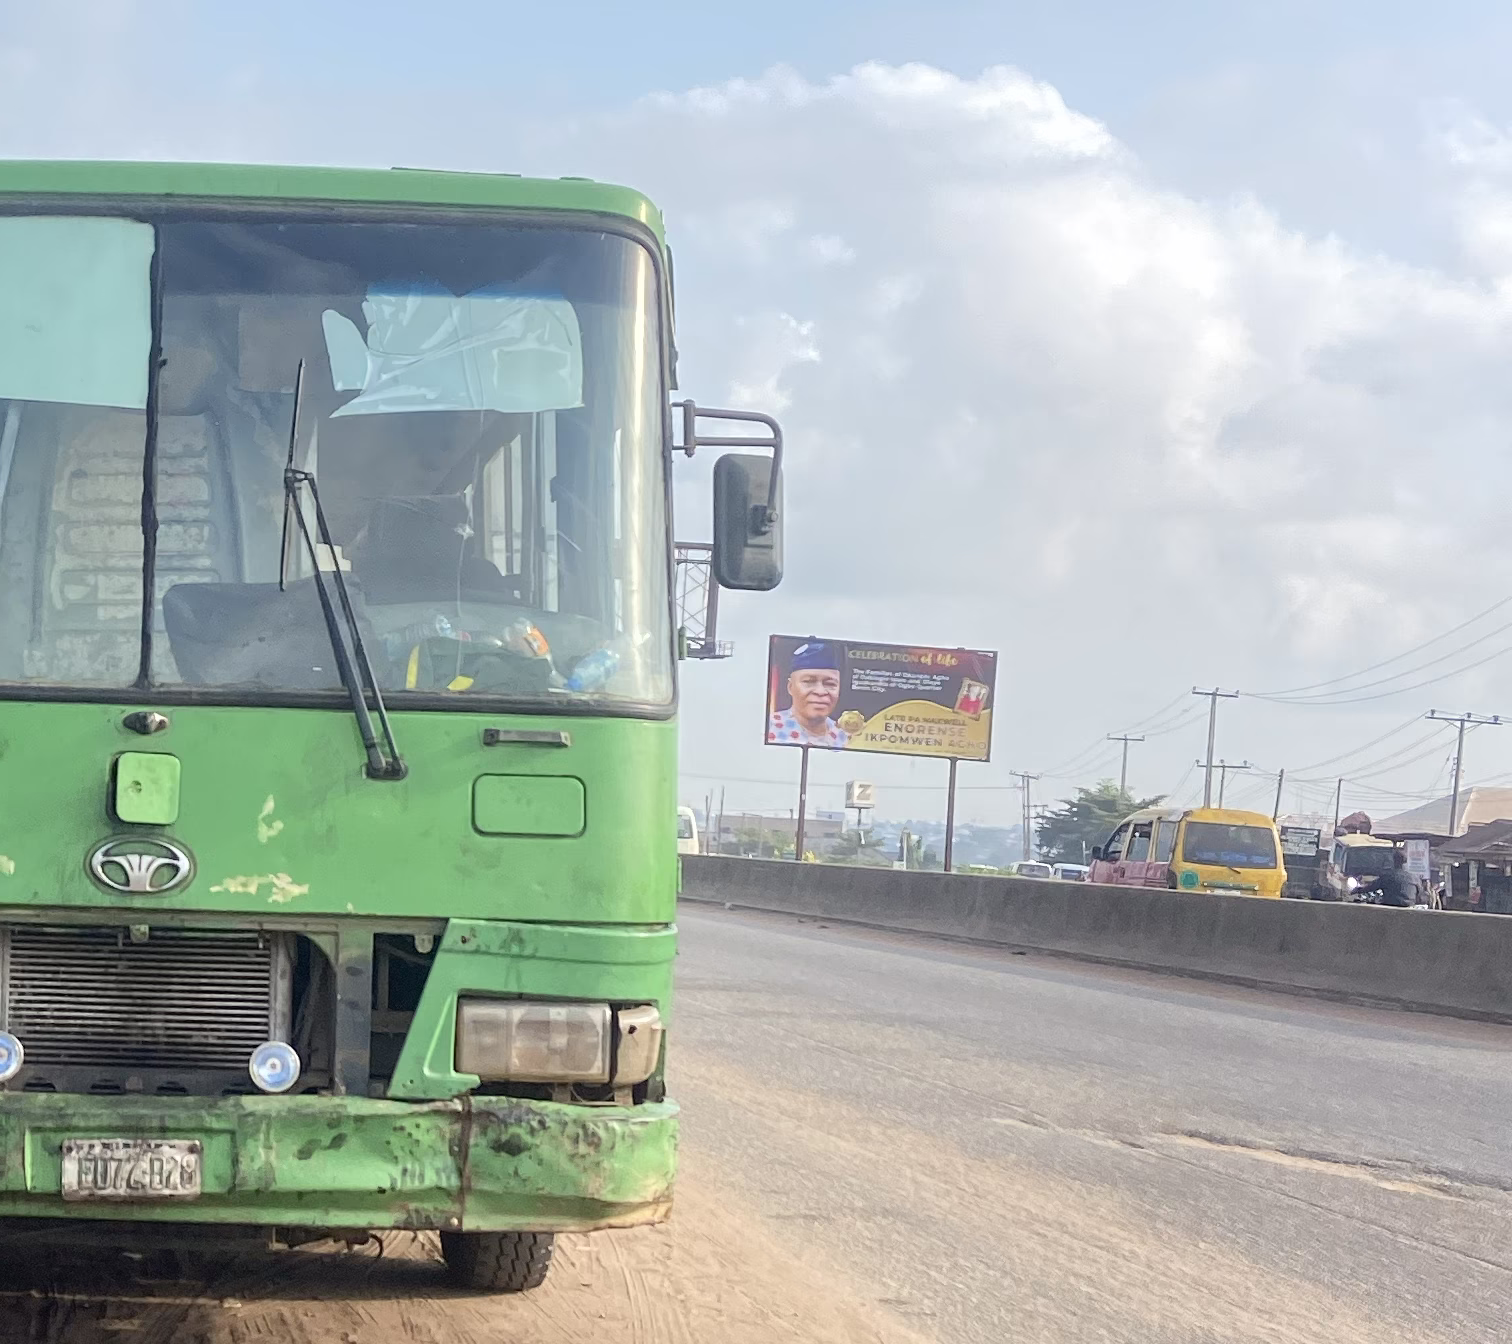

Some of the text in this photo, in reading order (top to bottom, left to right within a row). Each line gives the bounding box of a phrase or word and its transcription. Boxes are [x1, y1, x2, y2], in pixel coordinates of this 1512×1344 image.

[848, 649, 958, 667] CELEBRATION of life
[884, 714, 905, 722] LATE
[908, 715, 921, 723] PA
[884, 722, 966, 737] ENORENSE
[865, 732, 943, 747] IKPOMWEN
[856, 783, 873, 801] Z
